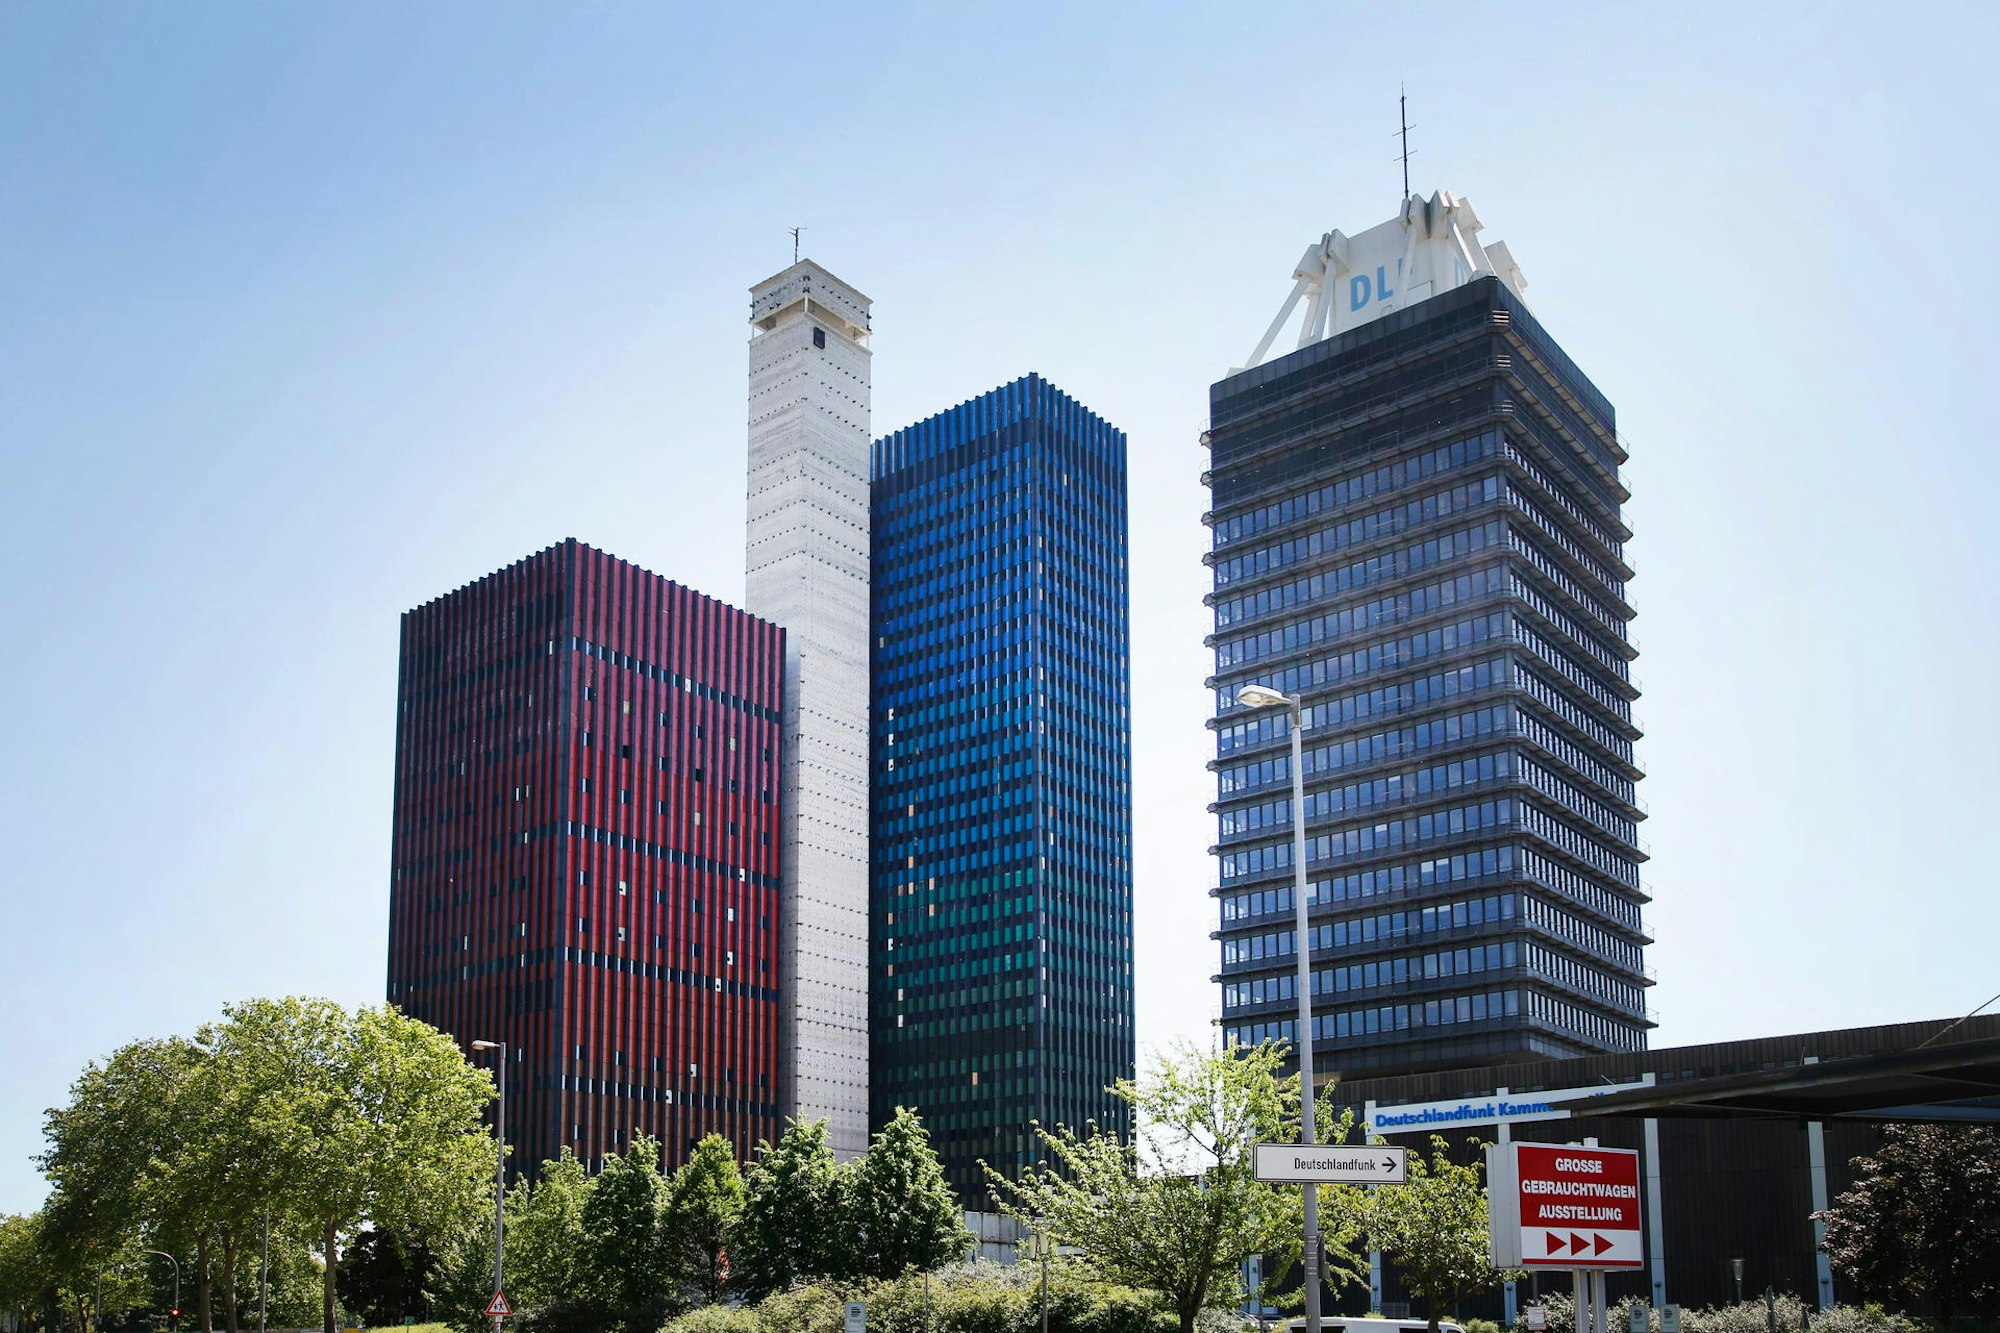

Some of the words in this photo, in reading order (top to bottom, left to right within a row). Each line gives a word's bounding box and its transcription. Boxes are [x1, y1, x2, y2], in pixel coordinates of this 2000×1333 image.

[1376, 1103, 1496, 1127] Deutschlandfunk
[1294, 1158, 1376, 1171] Deutschlandfunk
[1555, 1158, 1603, 1173] GROSSE
[1522, 1180, 1636, 1198] GEBRAUCHTWAGEN
[1538, 1204, 1622, 1222] AUSSTELLUNG
